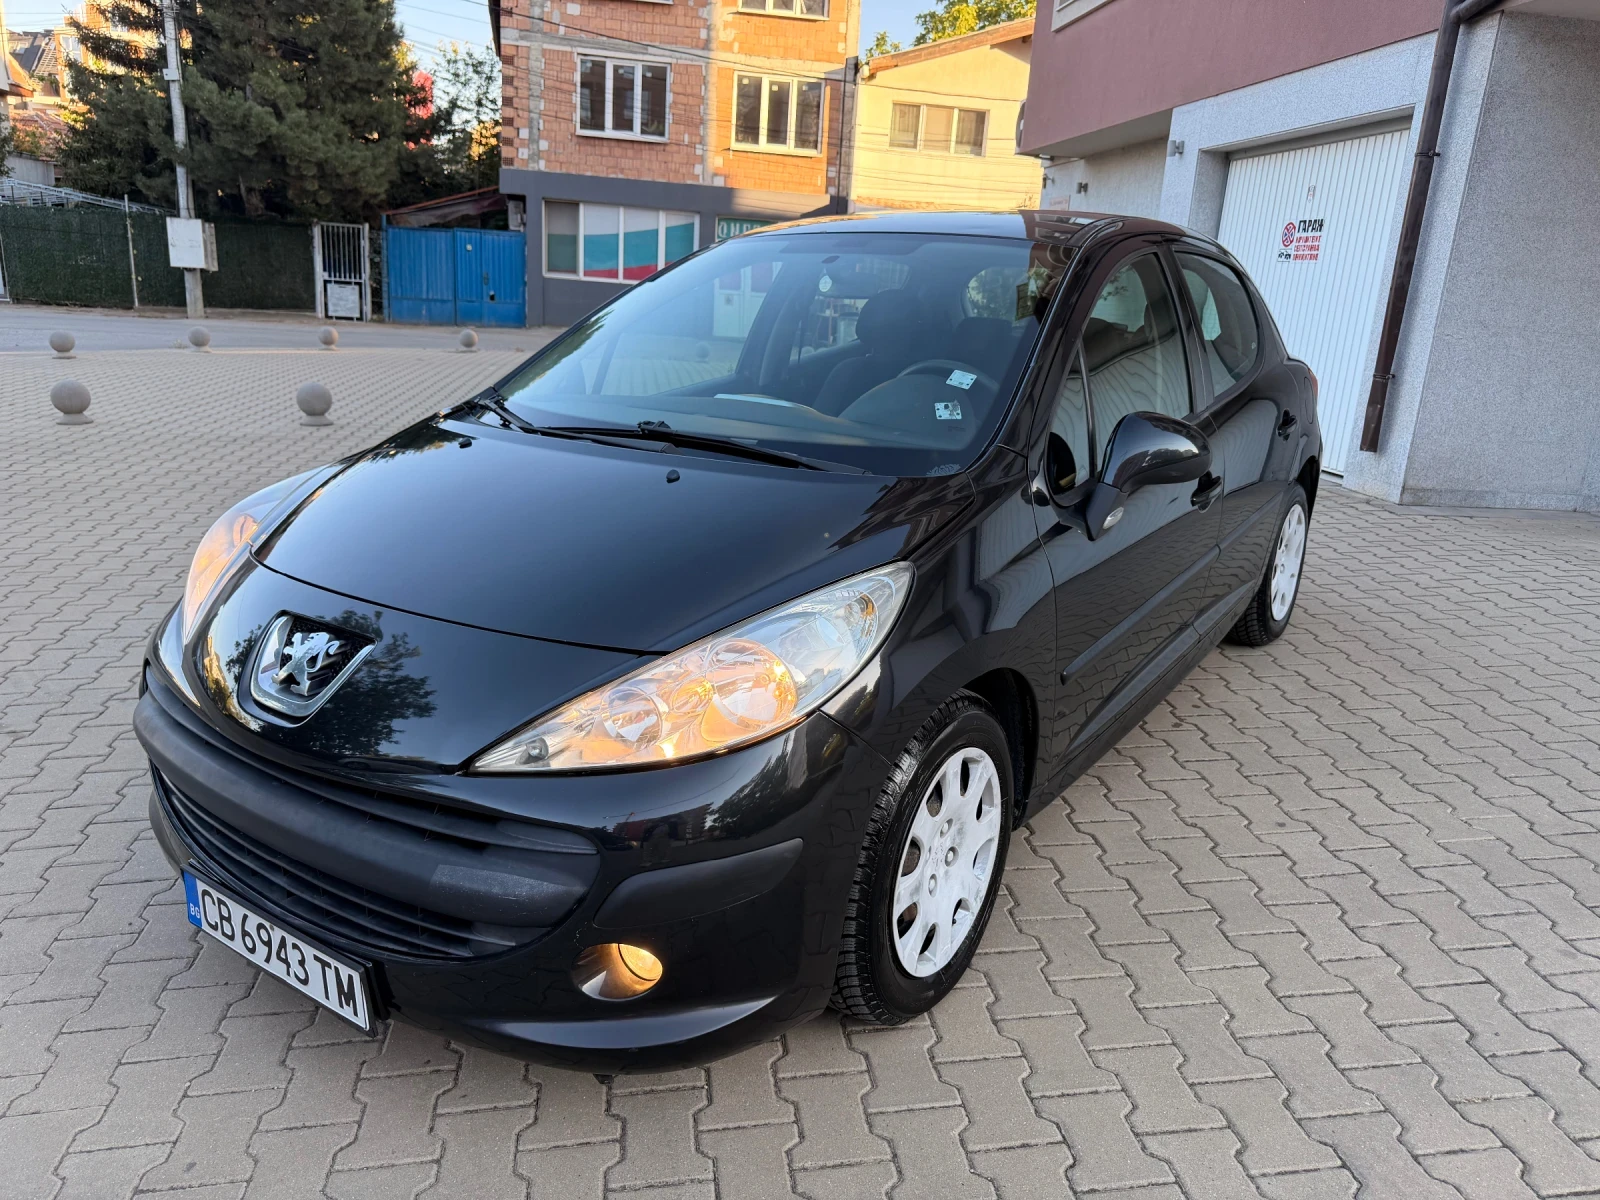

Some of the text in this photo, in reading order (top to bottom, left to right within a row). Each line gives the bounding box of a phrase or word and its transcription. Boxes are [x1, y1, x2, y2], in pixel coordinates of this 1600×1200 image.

[1297, 218, 1325, 233] ГАРАЖ
[189, 902, 200, 919] BG
[201, 888, 359, 1018] CB 6943 TM
